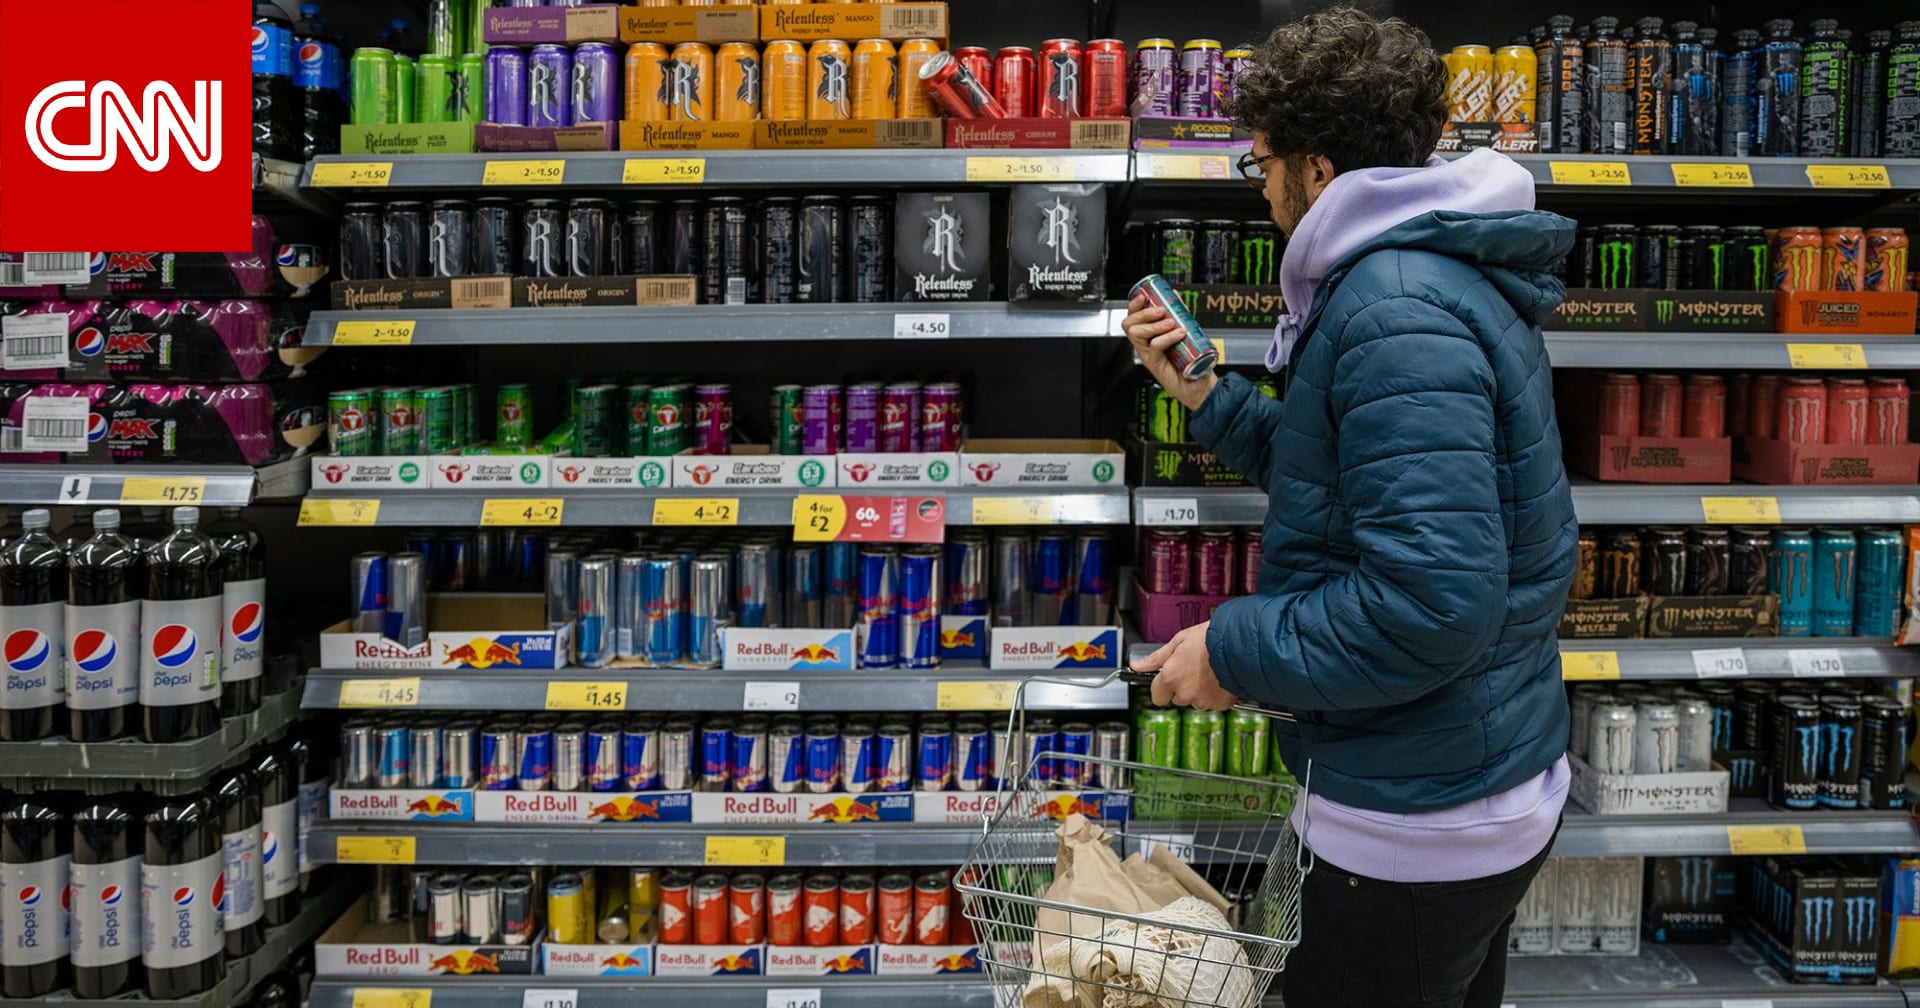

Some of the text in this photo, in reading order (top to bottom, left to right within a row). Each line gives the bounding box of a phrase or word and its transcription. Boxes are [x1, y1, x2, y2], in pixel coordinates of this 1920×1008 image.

[490, 17, 532, 33] Relentless
[627, 17, 668, 33] Relentless
[775, 9, 835, 33] Relentless
[1636, 54, 1654, 143] MONSTER
[643, 124, 740, 149] Relentless MANGO
[767, 122, 828, 145] Relentless
[954, 125, 1056, 147] Relentless CHERRY
[364, 131, 419, 154] Relentless
[1492, 139, 1538, 151] ALERT
[364, 169, 387, 179] £1.50
[523, 167, 560, 177] 2 £1.50
[663, 166, 701, 175] 2 £1.50
[1006, 164, 1043, 174] 2 £1.50
[1601, 169, 1625, 178] £2.50
[1724, 171, 1748, 180] £2.50
[1860, 172, 1884, 181] £2.50
[108, 252, 158, 273] MAX
[1027, 263, 1089, 291] Relentless
[913, 272, 973, 300] Relentless
[343, 287, 440, 310] Relentless ORIGIN
[527, 284, 625, 307] Relentless ORIGIN
[1553, 301, 1637, 316] MONSTER
[1678, 301, 1766, 317] MONSTER
[1819, 303, 1860, 313] JUICED
[1566, 316, 1622, 324] ENERGY
[1693, 317, 1751, 325] ENERGY
[109, 324, 133, 334] pepsi
[373, 327, 410, 338] 2 £1.50
[912, 321, 946, 335] £4.50
[105, 333, 157, 353] MAX
[104, 364, 141, 372] CHERRY
[113, 409, 137, 419] pepsi
[108, 418, 161, 440] MAX
[108, 449, 144, 457] CHERRY
[732, 463, 781, 475] Carabao
[1024, 463, 1068, 474] Carabao
[1631, 457, 1685, 468] MONSTER
[356, 466, 391, 475] Carabao
[476, 465, 512, 475] Carabao
[593, 466, 632, 476] Carabao
[882, 465, 921, 475] Carabao
[1821, 467, 1874, 478] MONSTER
[725, 477, 783, 485] ENERGY DRINK
[162, 486, 199, 501] £1.75
[523, 506, 558, 520] 4 £2
[694, 506, 730, 520] 4 £2
[809, 502, 833, 513] 4 for
[855, 506, 880, 523] 60p
[1165, 508, 1195, 521] £1.70
[810, 516, 829, 532] £2
[1563, 610, 1631, 624] MONSTER
[1682, 606, 1755, 620] MONSTER
[1574, 624, 1619, 633] MULE
[737, 643, 789, 655] Red Bull
[1003, 642, 1054, 655] Red Bull
[355, 660, 432, 669] ENERGY DRINK
[1715, 659, 1744, 671] £1.70
[1811, 659, 1840, 671] £1.70
[6, 676, 47, 692] pepsi
[75, 677, 114, 692] pepsi
[153, 673, 193, 688] pepsi
[378, 689, 414, 703] £1.45
[586, 691, 621, 705] £1.45
[785, 693, 797, 705] £2
[1638, 786, 1714, 799] MONSTER
[340, 795, 398, 809] Red Bull
[505, 795, 577, 812] Red Bull
[725, 797, 798, 814] Red Bull
[946, 795, 982, 812] Red
[505, 814, 544, 822] ENERGY
[1662, 913, 1725, 925] MONSTER
[22, 907, 39, 949] pepsi
[103, 907, 121, 949] pepsi
[173, 907, 193, 949] pepsi
[346, 948, 420, 965] Red Bull
[550, 951, 595, 963] Red Bull
[661, 954, 706, 964] Red Bull
[771, 955, 817, 966] Red Bull
[882, 954, 928, 965] Red Bull
[368, 966, 400, 976] ZERO
